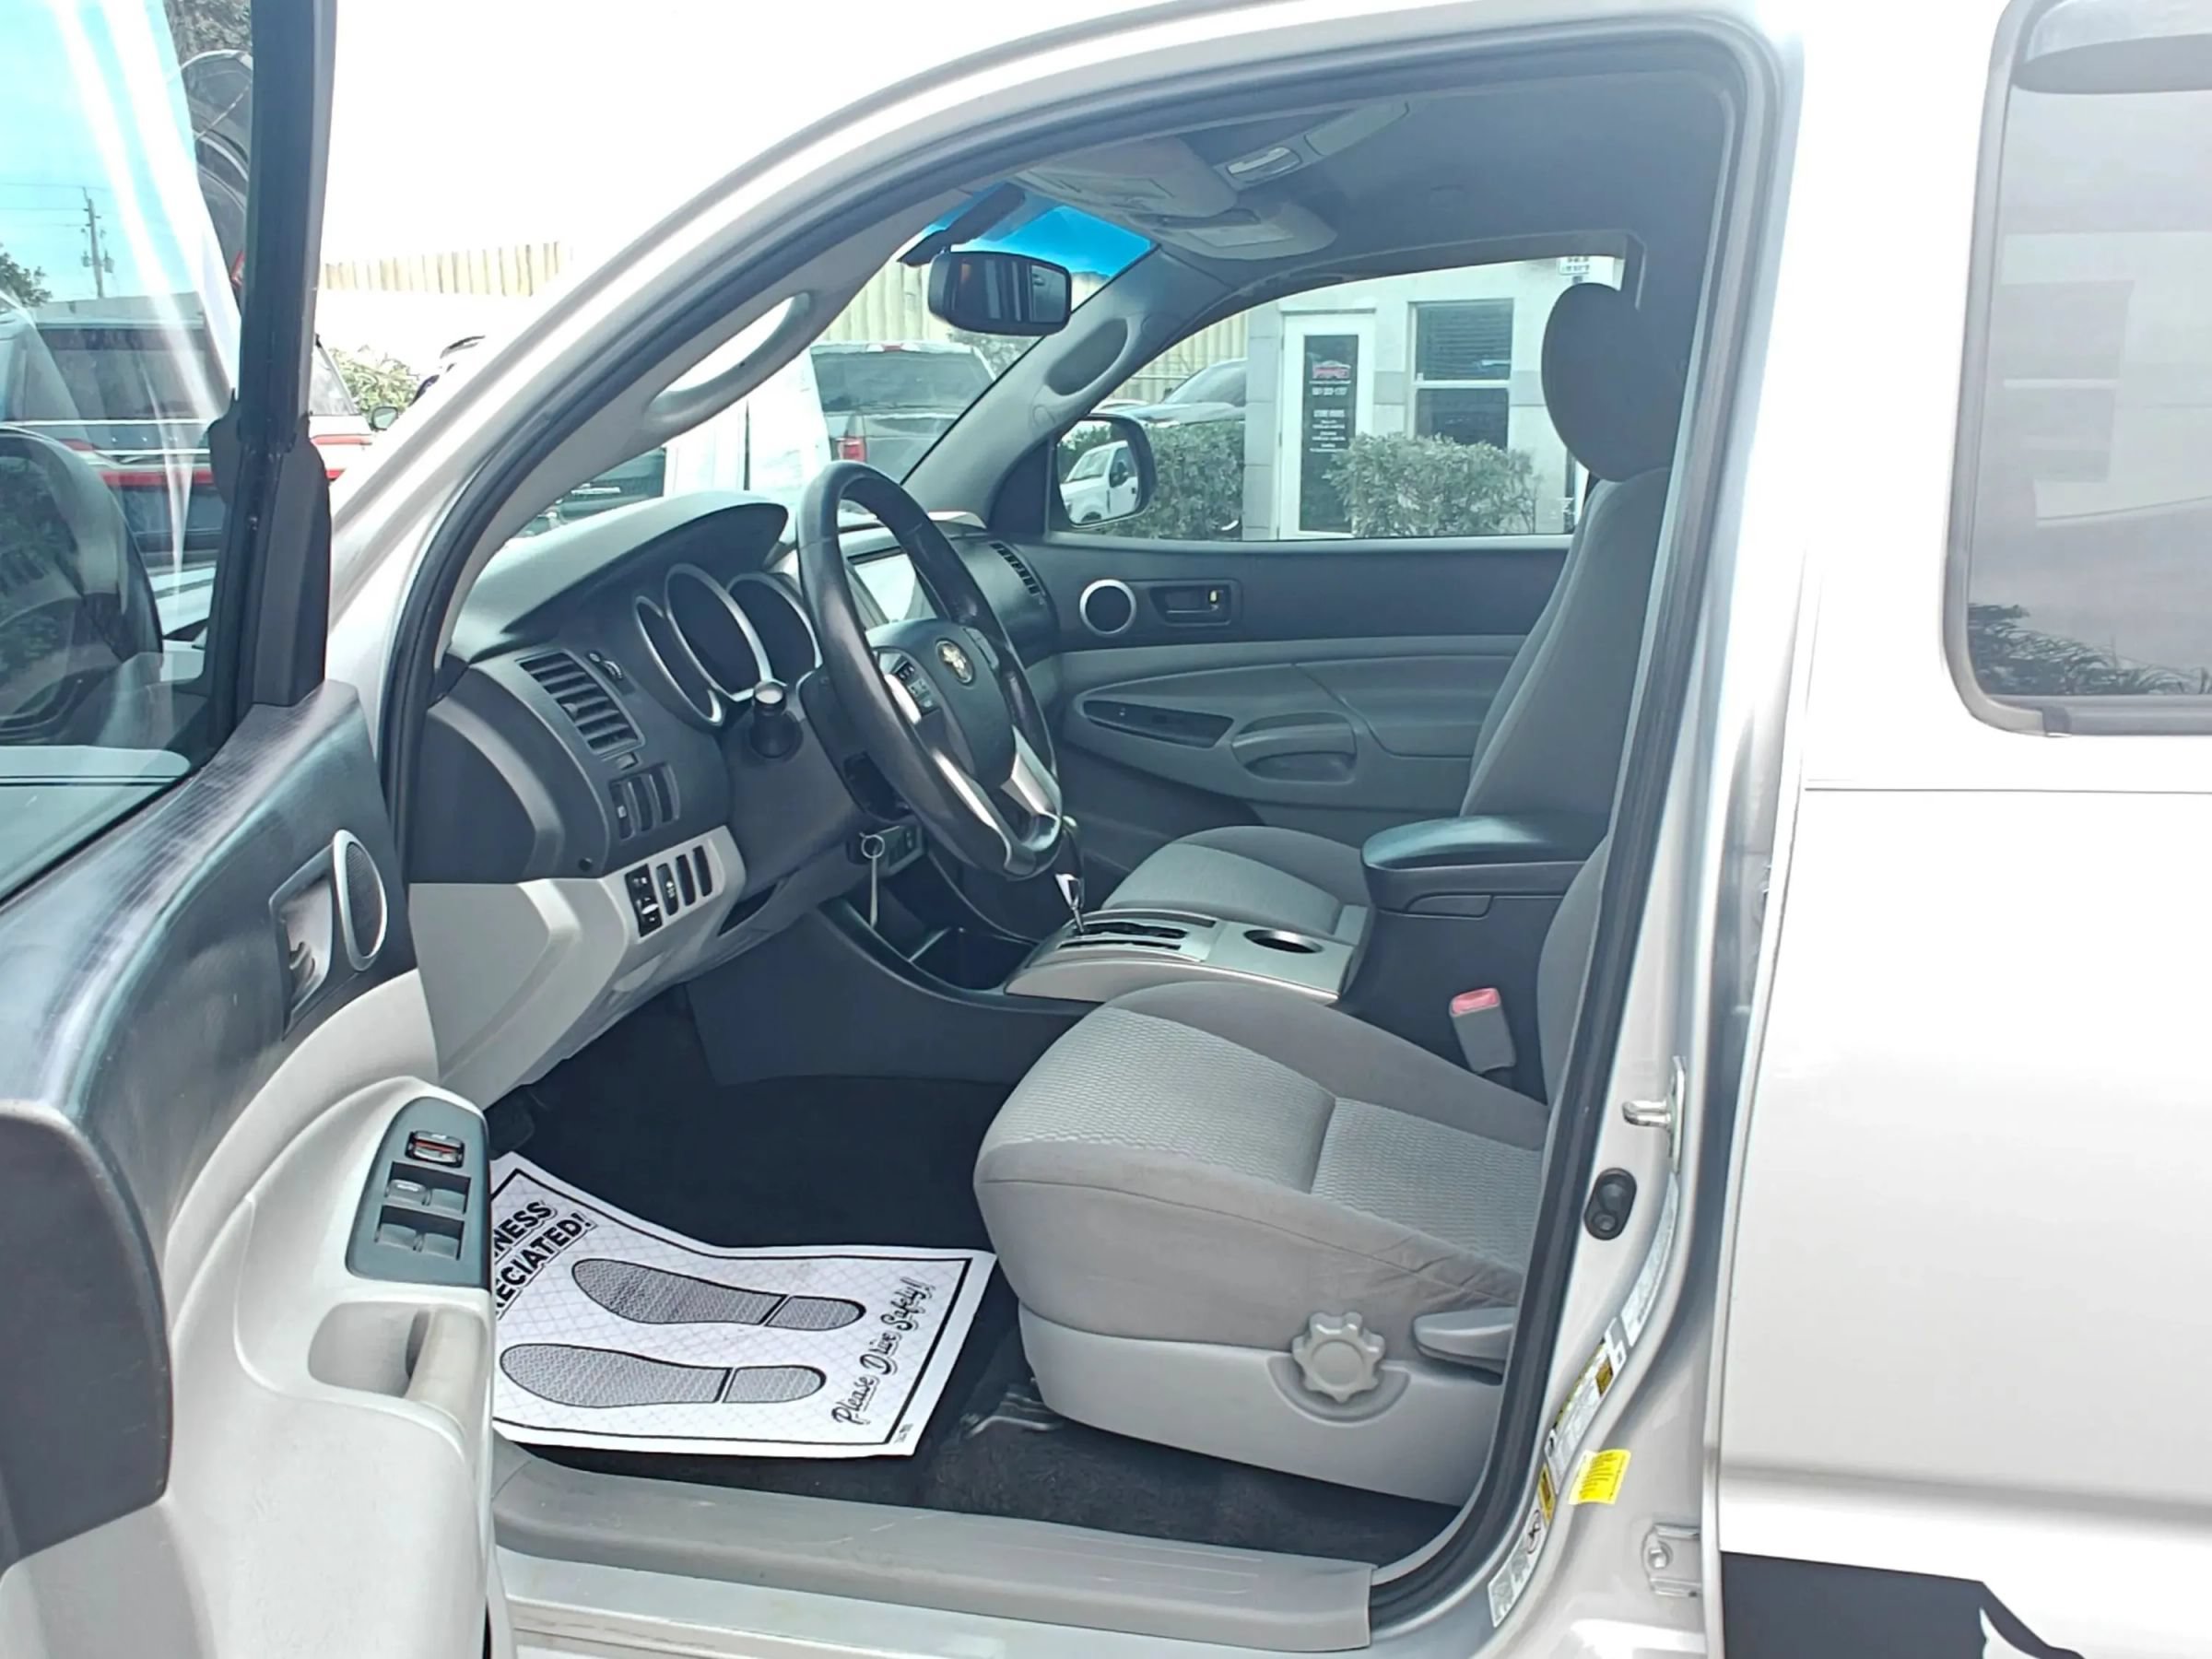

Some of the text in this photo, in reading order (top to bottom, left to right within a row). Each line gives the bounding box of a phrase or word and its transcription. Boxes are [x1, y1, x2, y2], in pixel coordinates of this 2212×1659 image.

[493, 1201, 553, 1258] NESS
[831, 1375, 875, 1425] Please
[859, 1331, 901, 1375] Drive
